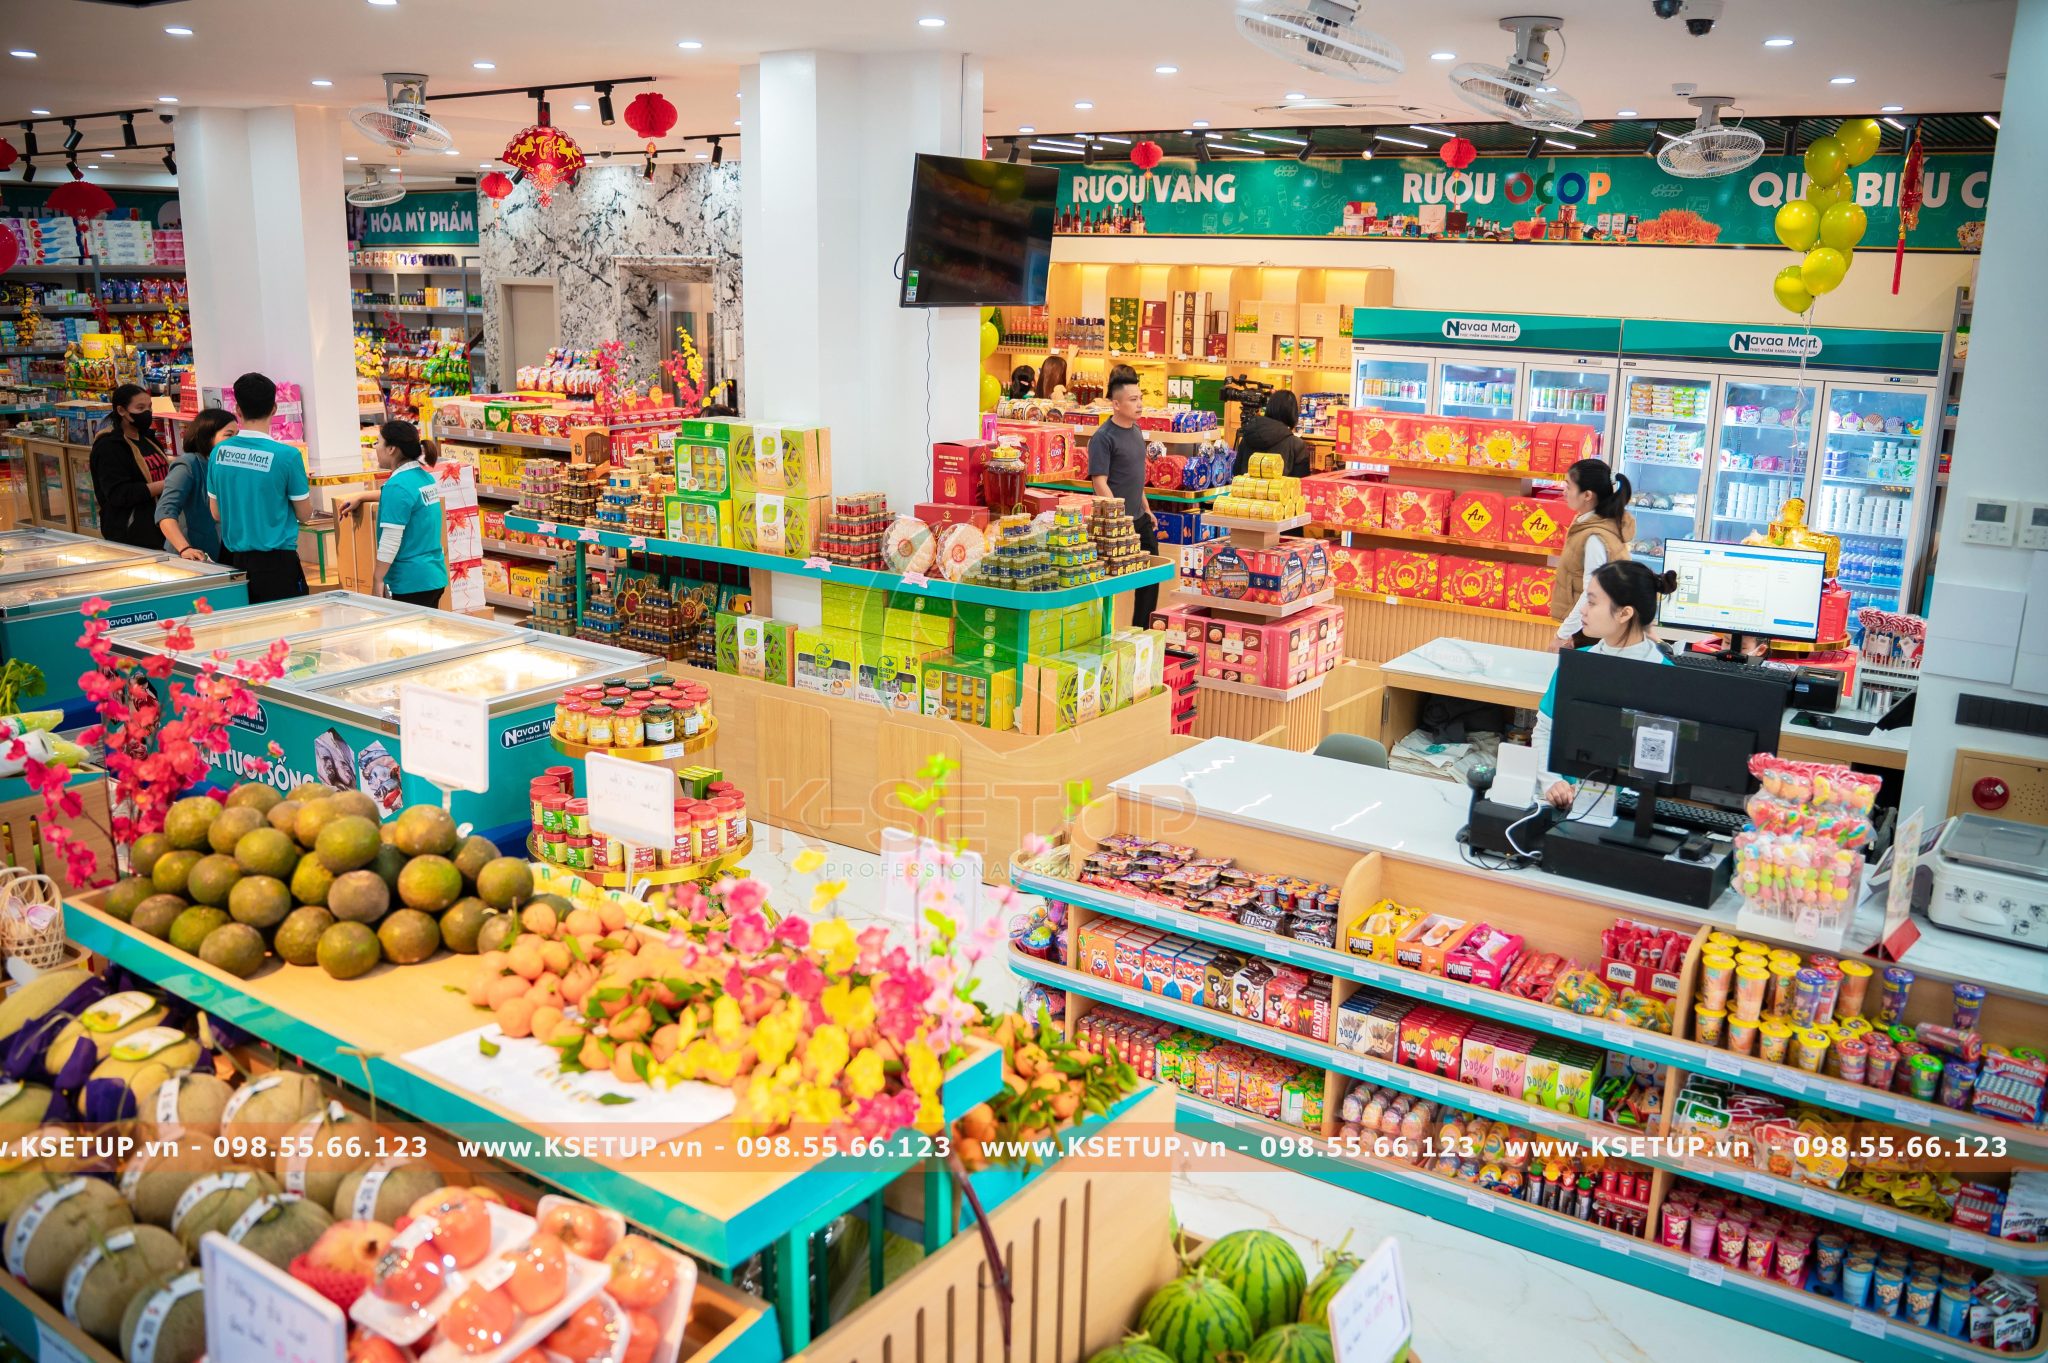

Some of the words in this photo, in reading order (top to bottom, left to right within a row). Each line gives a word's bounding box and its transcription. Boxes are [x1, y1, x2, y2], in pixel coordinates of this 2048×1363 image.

[1152, 173, 1236, 204] VANG
[1504, 172, 1611, 205] OCOP
[1856, 157, 1951, 209] BIU
[1961, 171, 1988, 208] C
[370, 207, 403, 233] HÓA
[405, 207, 426, 233] MỸ
[429, 201, 474, 232] PHẨM
[1446, 320, 1488, 337] Navaa
[1734, 333, 1783, 351] Navaa
[216, 449, 246, 462] Navaa
[1467, 508, 1486, 522] An
[1529, 516, 1550, 531] An
[107, 617, 132, 628] avaa
[878, 666, 896, 675] GREEN
[878, 672, 891, 680] BIRD
[504, 724, 540, 747] Navaa
[1349, 937, 1373, 951] PONNIE
[1397, 949, 1422, 962] PONNIE
[1446, 962, 1472, 976] PONNIE
[1610, 966, 1633, 980] PONNIE
[1654, 977, 1678, 990] PONNIE
[1338, 1027, 1363, 1043] POCKY
[1400, 1040, 1427, 1058] POCKY
[1430, 1048, 1457, 1067] POCKY
[1463, 1058, 1490, 1075] POCKY
[2001, 1062, 2042, 1081] EVEREADY
[1494, 1067, 1521, 1084] POCKY
[1526, 1075, 1554, 1092] POCKY
[1558, 1084, 1587, 1101] POCKY
[1980, 1094, 2029, 1114] EVEREADY
[1956, 1209, 1988, 1222] EVEREADY
[1973, 1319, 1994, 1331] Ener
[1995, 1318, 2030, 1340] Energizer
